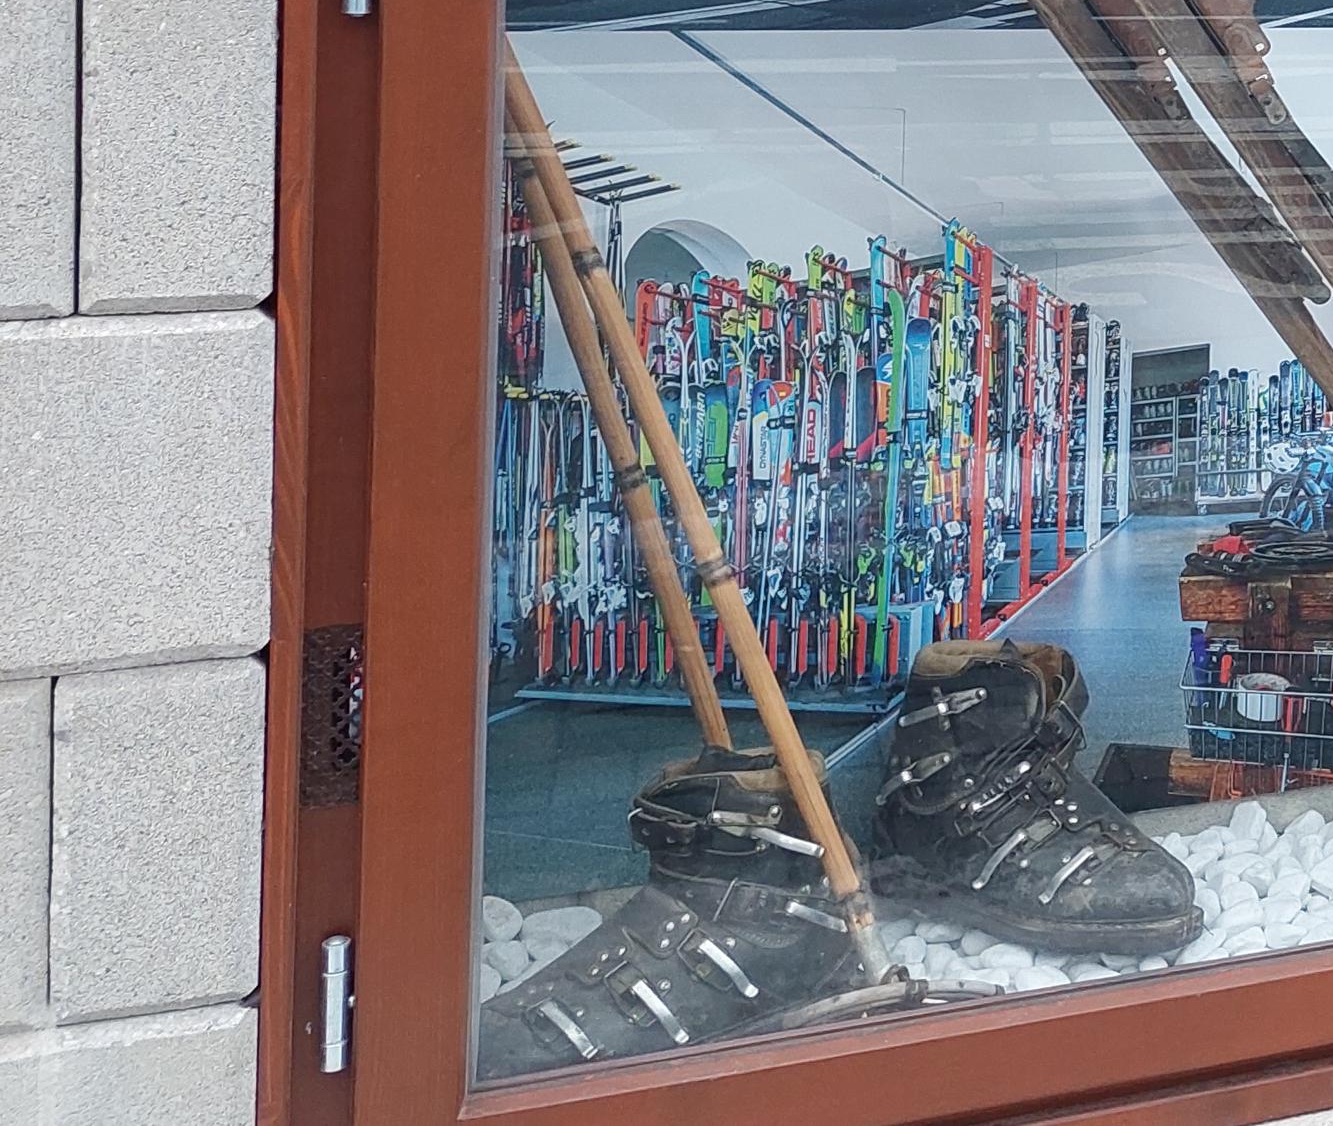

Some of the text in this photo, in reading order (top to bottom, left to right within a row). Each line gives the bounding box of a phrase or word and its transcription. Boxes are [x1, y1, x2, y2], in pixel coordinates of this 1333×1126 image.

[695, 391, 706, 459] BLIZZARD
[759, 425, 768, 469] DYNASTAR
[806, 408, 816, 463] HEAD
